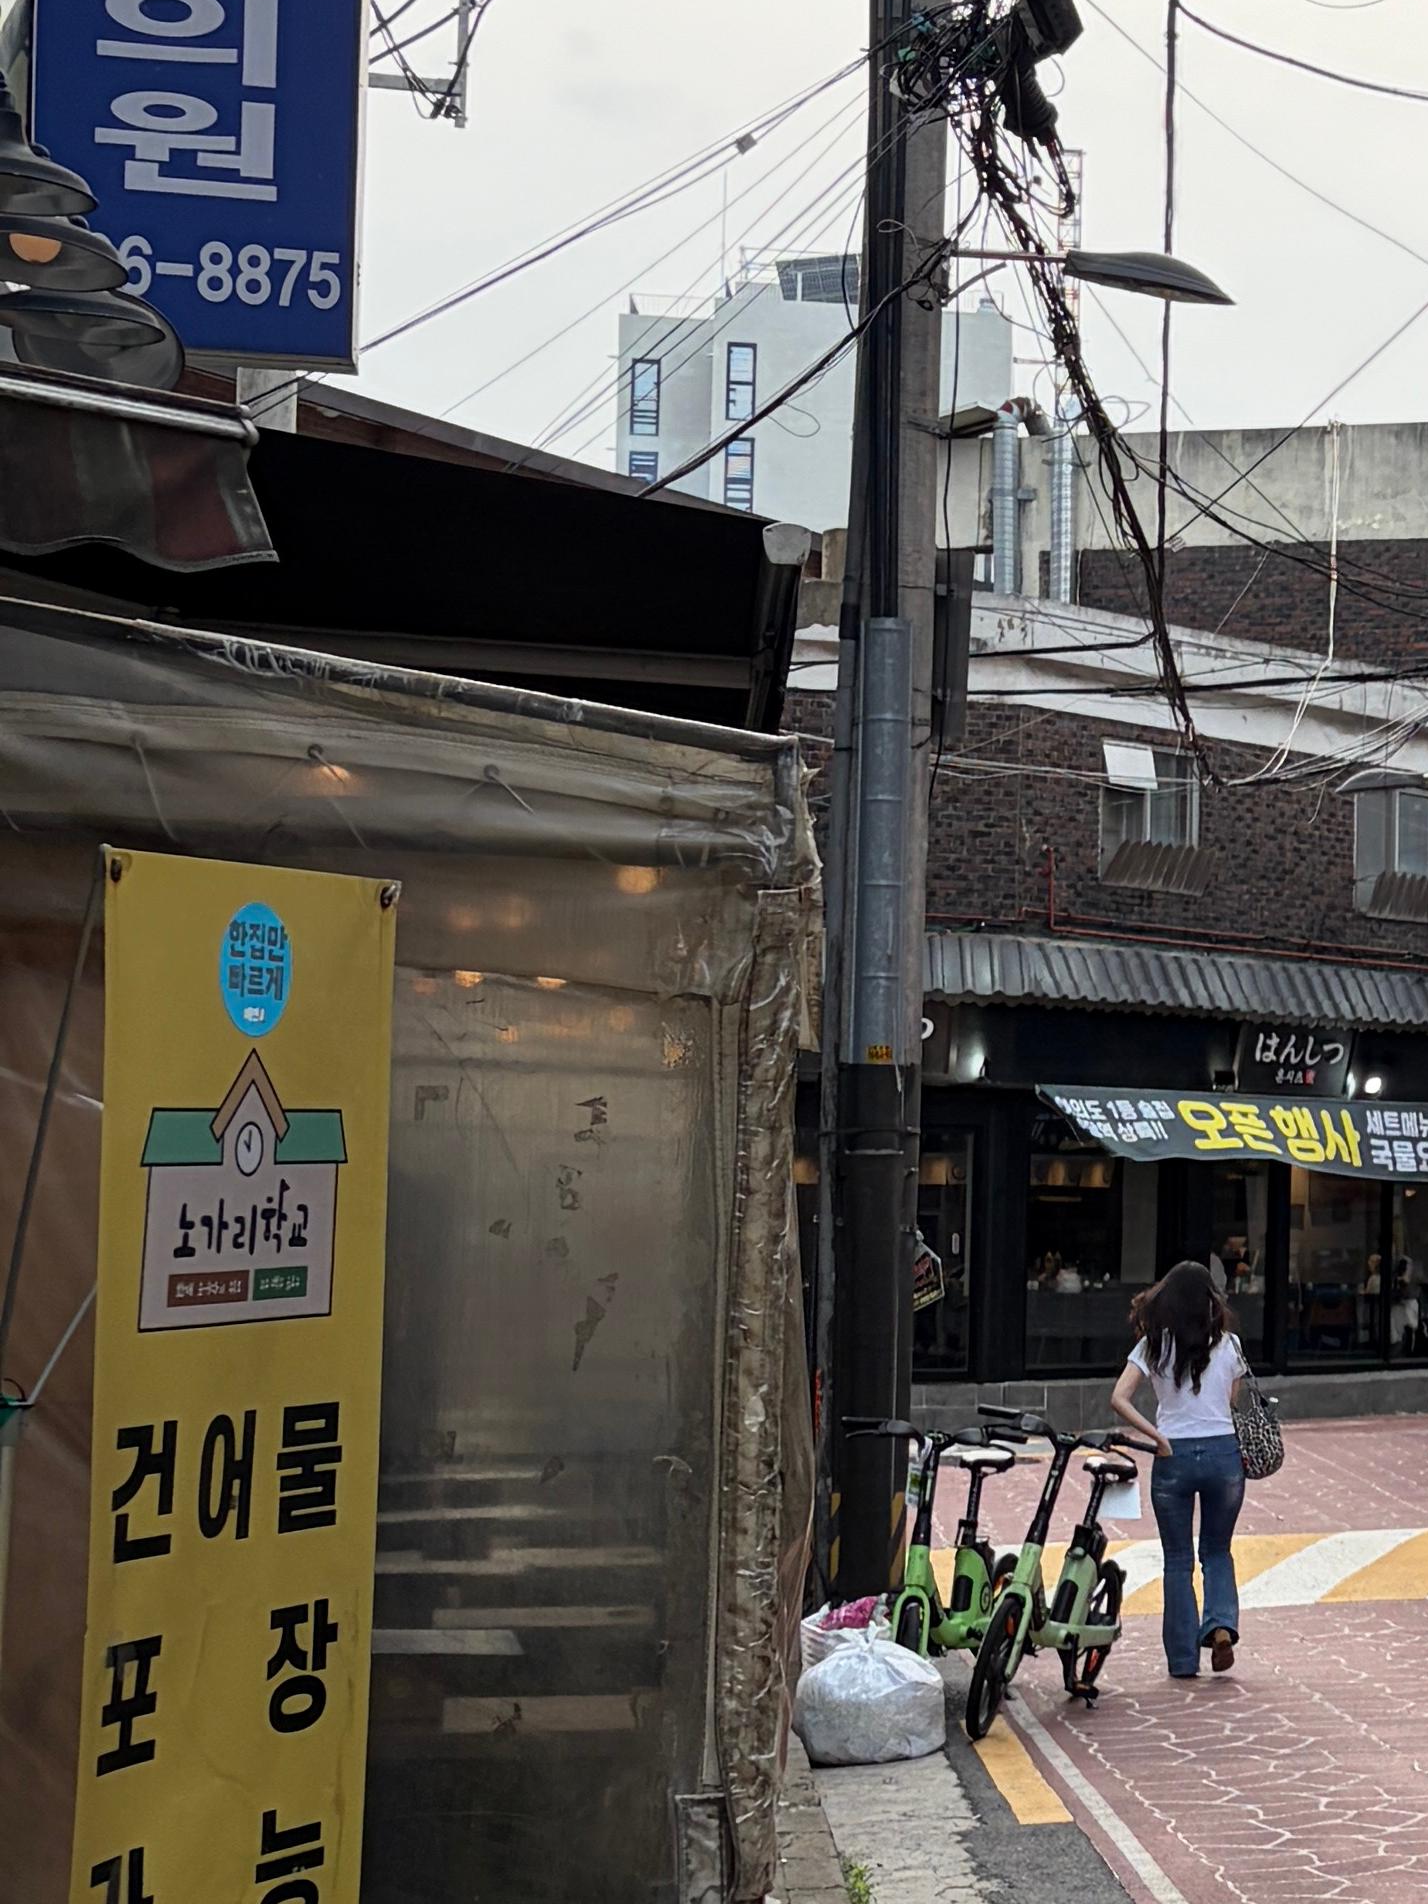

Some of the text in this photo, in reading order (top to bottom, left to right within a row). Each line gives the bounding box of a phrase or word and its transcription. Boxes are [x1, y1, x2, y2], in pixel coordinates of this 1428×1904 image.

[92, 232, 342, 310] 6-8875
[1255, 1031, 1346, 1066] はんしつ
[1177, 1098, 1363, 1169] 오픈 행사
[173, 1178, 310, 1259] 노가리학교
[110, 1401, 343, 1565] 건어물
[96, 1597, 340, 1779] 포장
